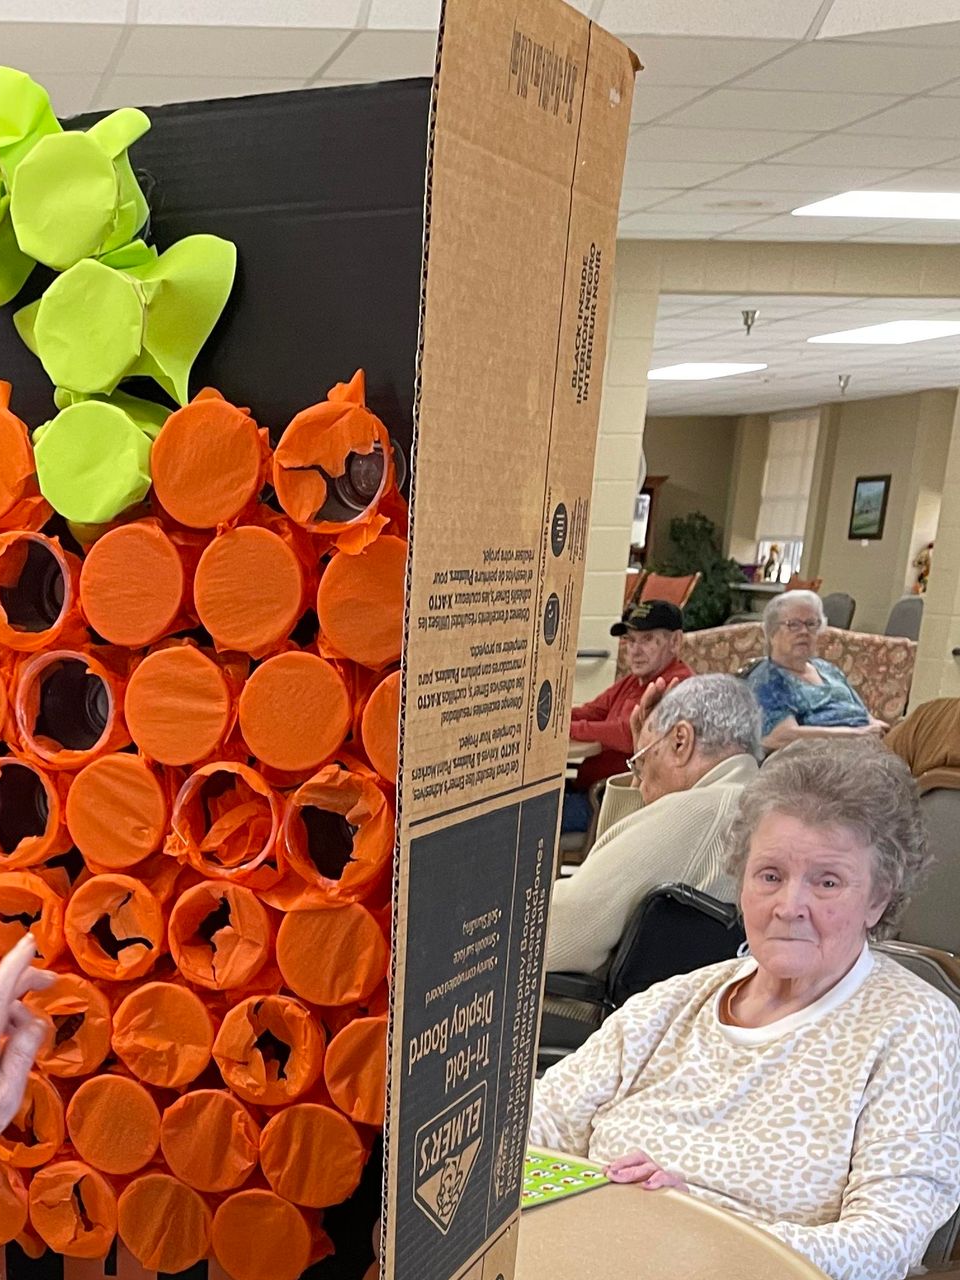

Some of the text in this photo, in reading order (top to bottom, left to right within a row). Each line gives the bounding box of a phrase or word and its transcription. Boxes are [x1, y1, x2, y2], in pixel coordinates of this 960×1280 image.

[592, 249, 601, 298] NOIR
[571, 255, 588, 387] BLACK INSIDE
[576, 242, 595, 404] INTERIOR NEGRO
[432, 569, 448, 585] pour
[478, 730, 491, 746] Your
[491, 722, 515, 743] Complete
[411, 763, 436, 784] Markers
[443, 775, 464, 794] Elmer's
[523, 837, 544, 996] presentaciones
[532, 928, 541, 973] trois
[424, 982, 444, 1010] board
[506, 1035, 519, 1113] Tri-Fold
[513, 956, 526, 1031] Display
[520, 887, 532, 951] Board
[407, 981, 494, 1076] Display Board
[519, 1001, 528, 1047] para
[444, 1030, 490, 1095] Tri-Fold
[418, 1095, 482, 1177] ELMER'S
[504, 1123, 517, 1197] Tablero
